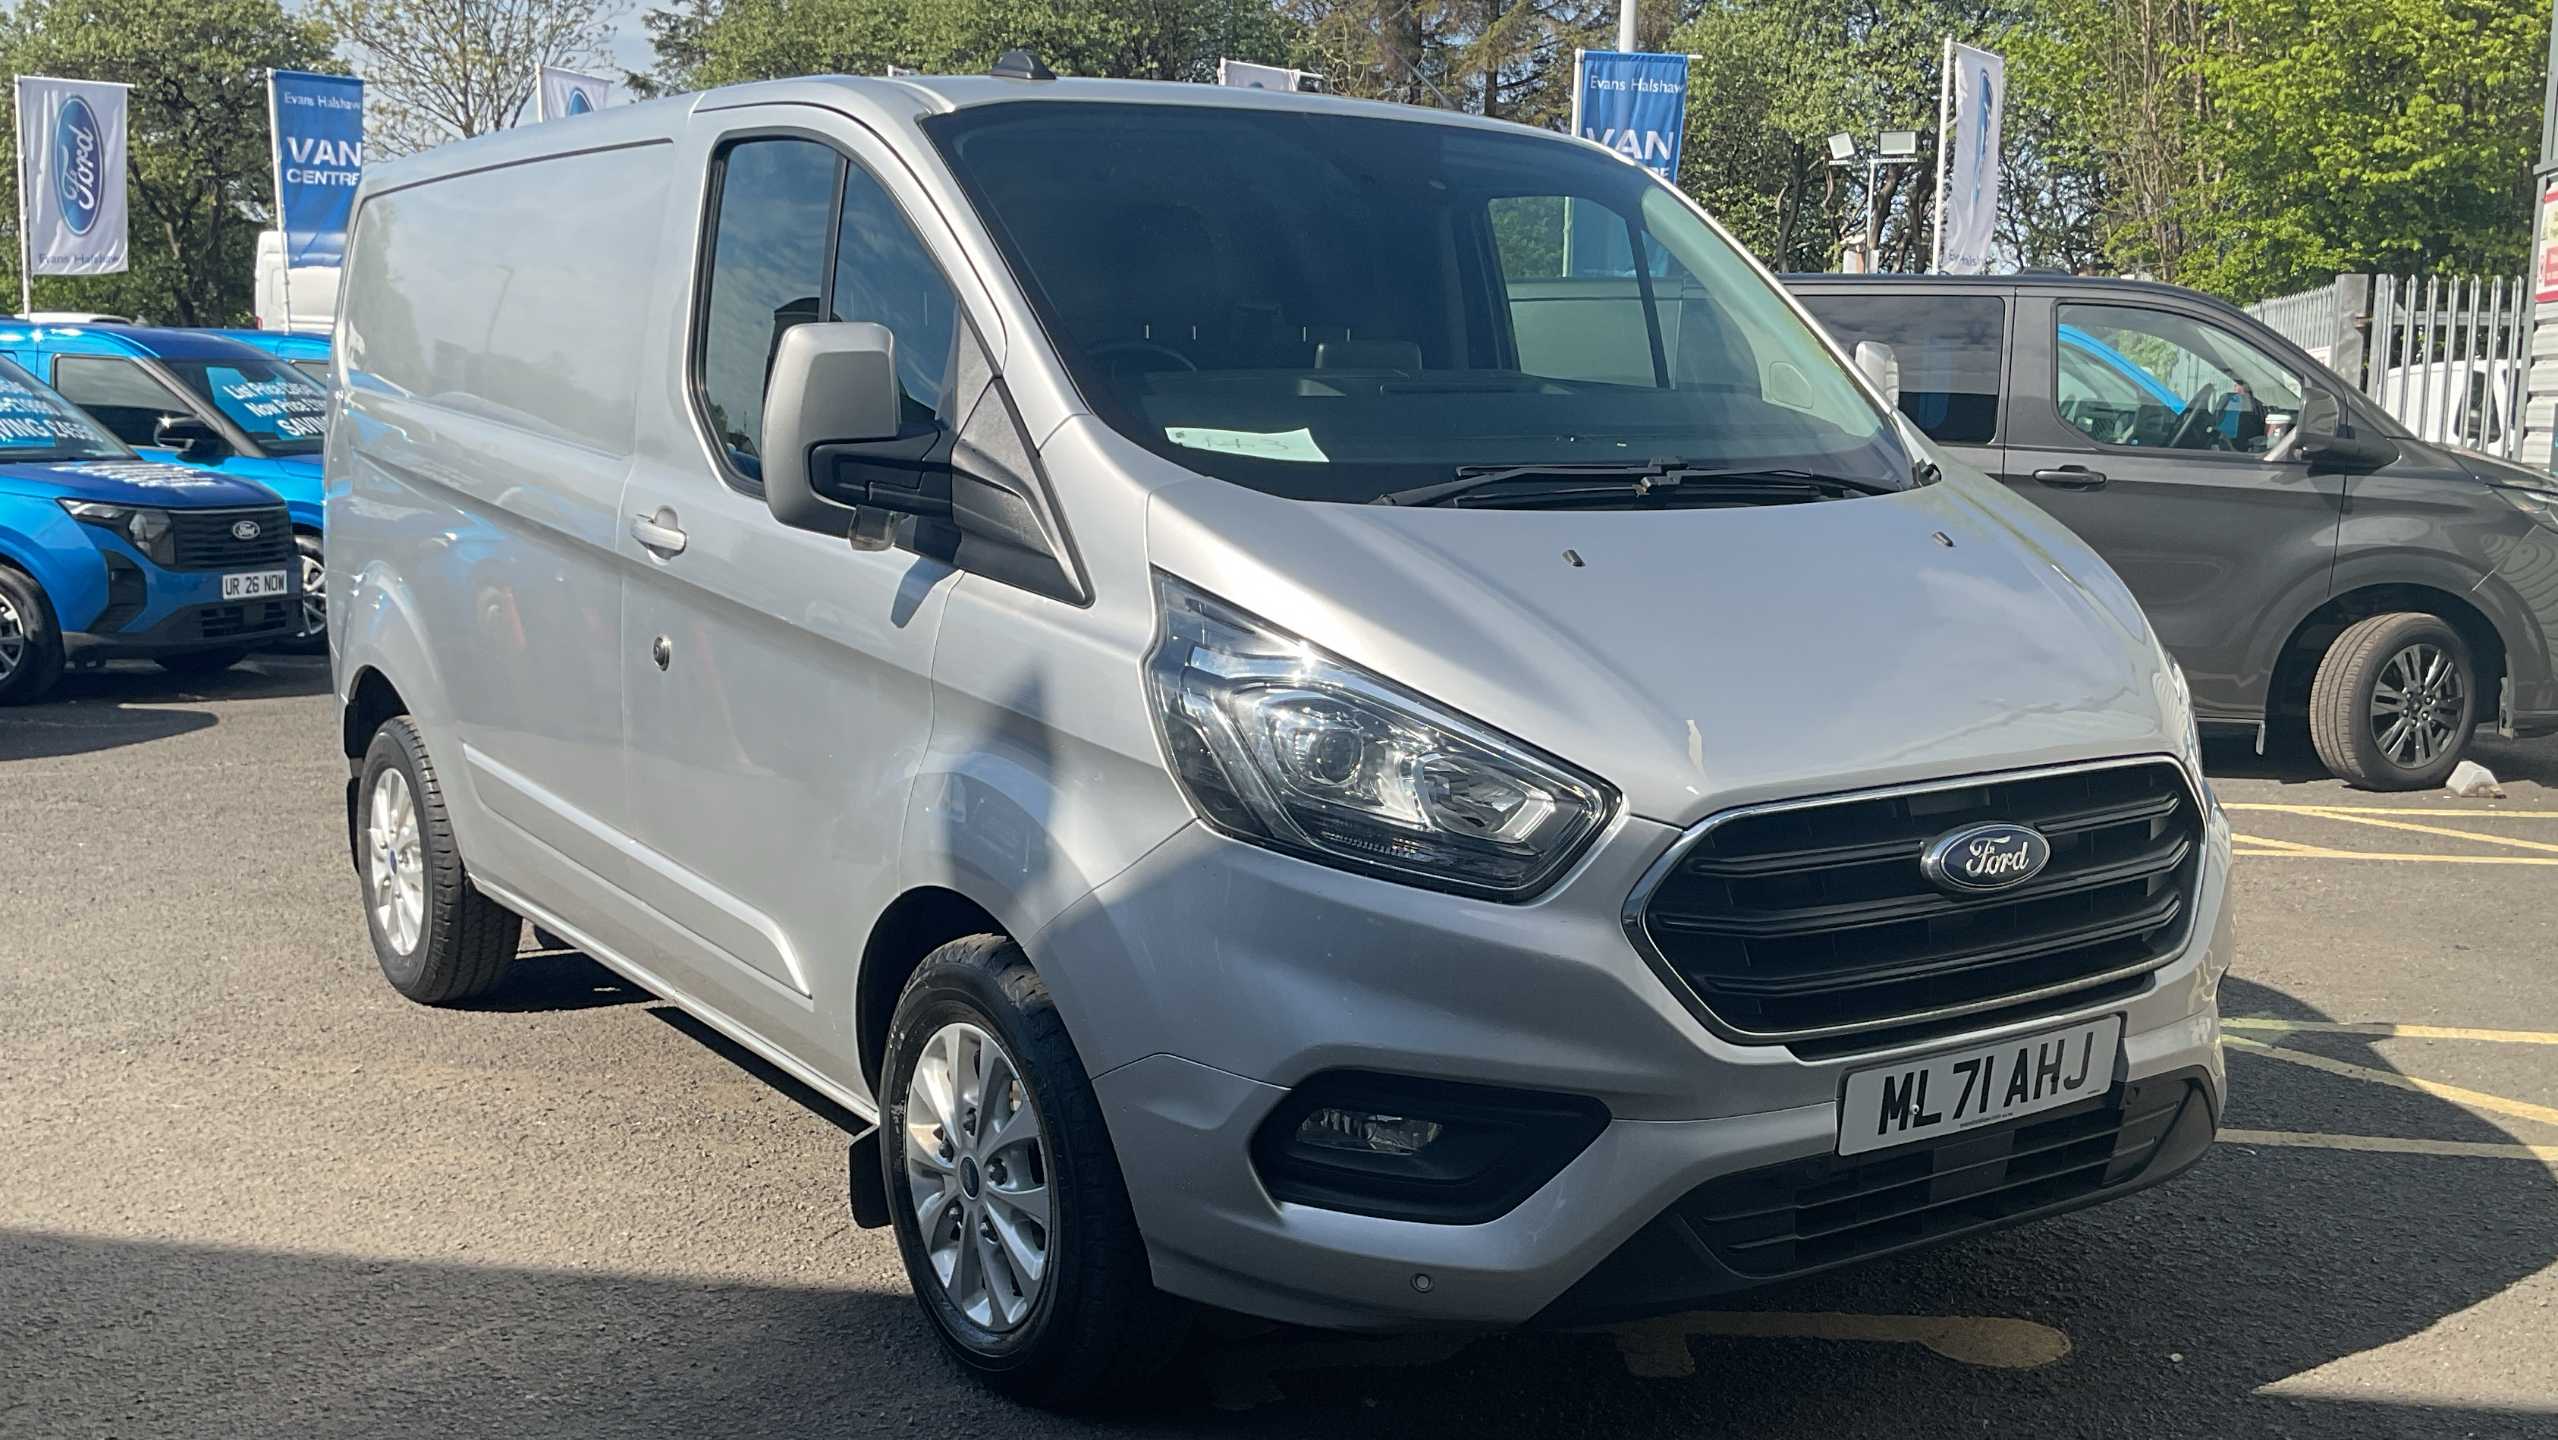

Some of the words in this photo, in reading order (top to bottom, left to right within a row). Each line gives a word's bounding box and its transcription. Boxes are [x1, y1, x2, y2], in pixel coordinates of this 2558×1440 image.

[1590, 75, 1626, 91] Evans
[1630, 78, 1684, 94] Halshaw
[285, 91, 314, 107] Evans
[317, 95, 361, 111] Halshaw
[286, 136, 362, 167] VAN
[1586, 127, 1674, 161] VAN
[61, 123, 95, 210] Ford
[286, 168, 361, 187] CENTRE
[225, 578, 240, 595] UR
[245, 576, 260, 594] 26
[264, 574, 285, 593] NOW
[1965, 835, 2030, 878] Ford
[2003, 1031, 2094, 1108] AHJ
